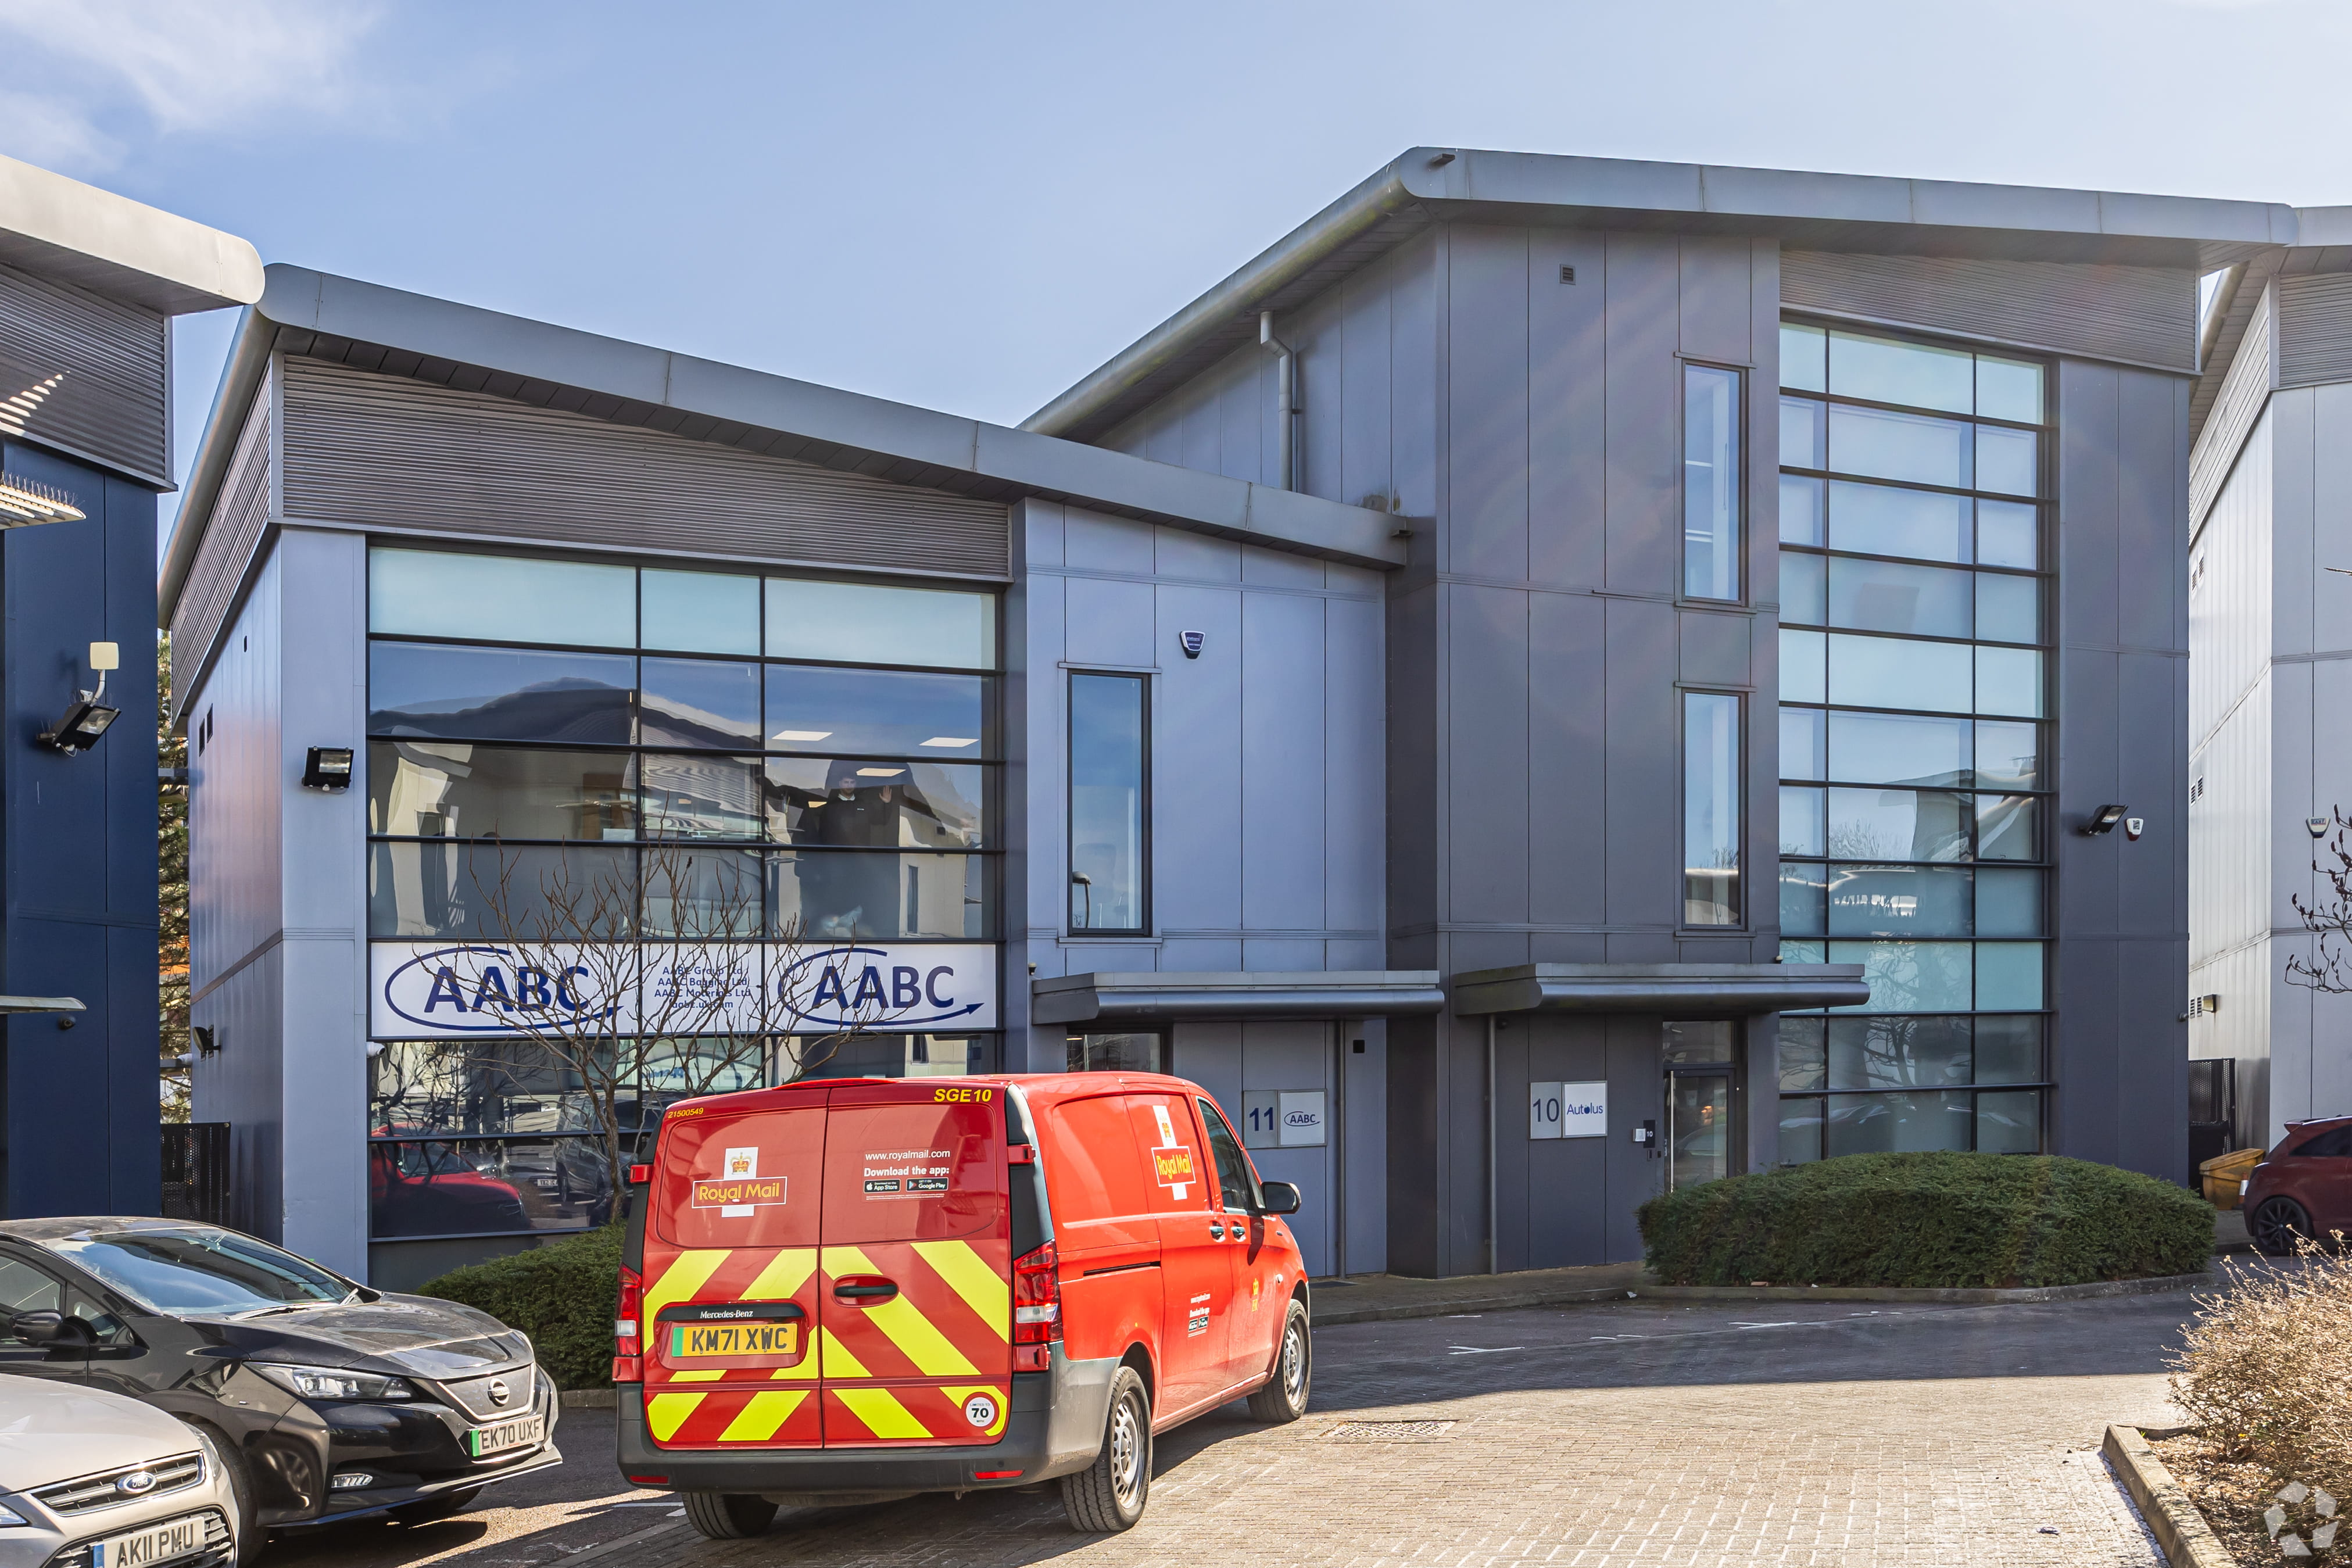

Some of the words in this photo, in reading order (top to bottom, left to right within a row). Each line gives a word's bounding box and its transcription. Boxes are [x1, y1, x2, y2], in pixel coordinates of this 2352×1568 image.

[694, 966, 724, 976] Goup
[728, 966, 743, 975] td
[424, 966, 589, 1013] AABC
[686, 989, 732, 997] Maerias
[735, 989, 750, 997] Ltd
[813, 965, 954, 1009] AABC
[672, 1000, 733, 1008] aabc.u.cm
[668, 1107, 704, 1119] 21500549
[1533, 1098, 1560, 1122] 10
[1566, 1102, 1603, 1115] Autolus
[1250, 1107, 1273, 1131] 11
[1290, 1114, 1316, 1124] AABC
[865, 1150, 951, 1161] www.royalmail.com
[864, 1166, 910, 1177] Download
[912, 1165, 927, 1175] the
[929, 1166, 950, 1176] app:
[1156, 1154, 1177, 1180] Royal
[1176, 1154, 1191, 1174] Mail
[699, 1184, 742, 1203] Royal
[744, 1182, 779, 1198] Mail
[700, 1310, 754, 1318] Mercedes-Benz
[692, 1329, 739, 1352] KM71
[746, 1327, 787, 1350] XWC
[971, 1408, 989, 1418] 70
[481, 1424, 515, 1450] EK70
[519, 1419, 540, 1441] UXF
[133, 1476, 148, 1487] Ford
[117, 1534, 153, 1568] AK11
[159, 1523, 194, 1557] PMU
